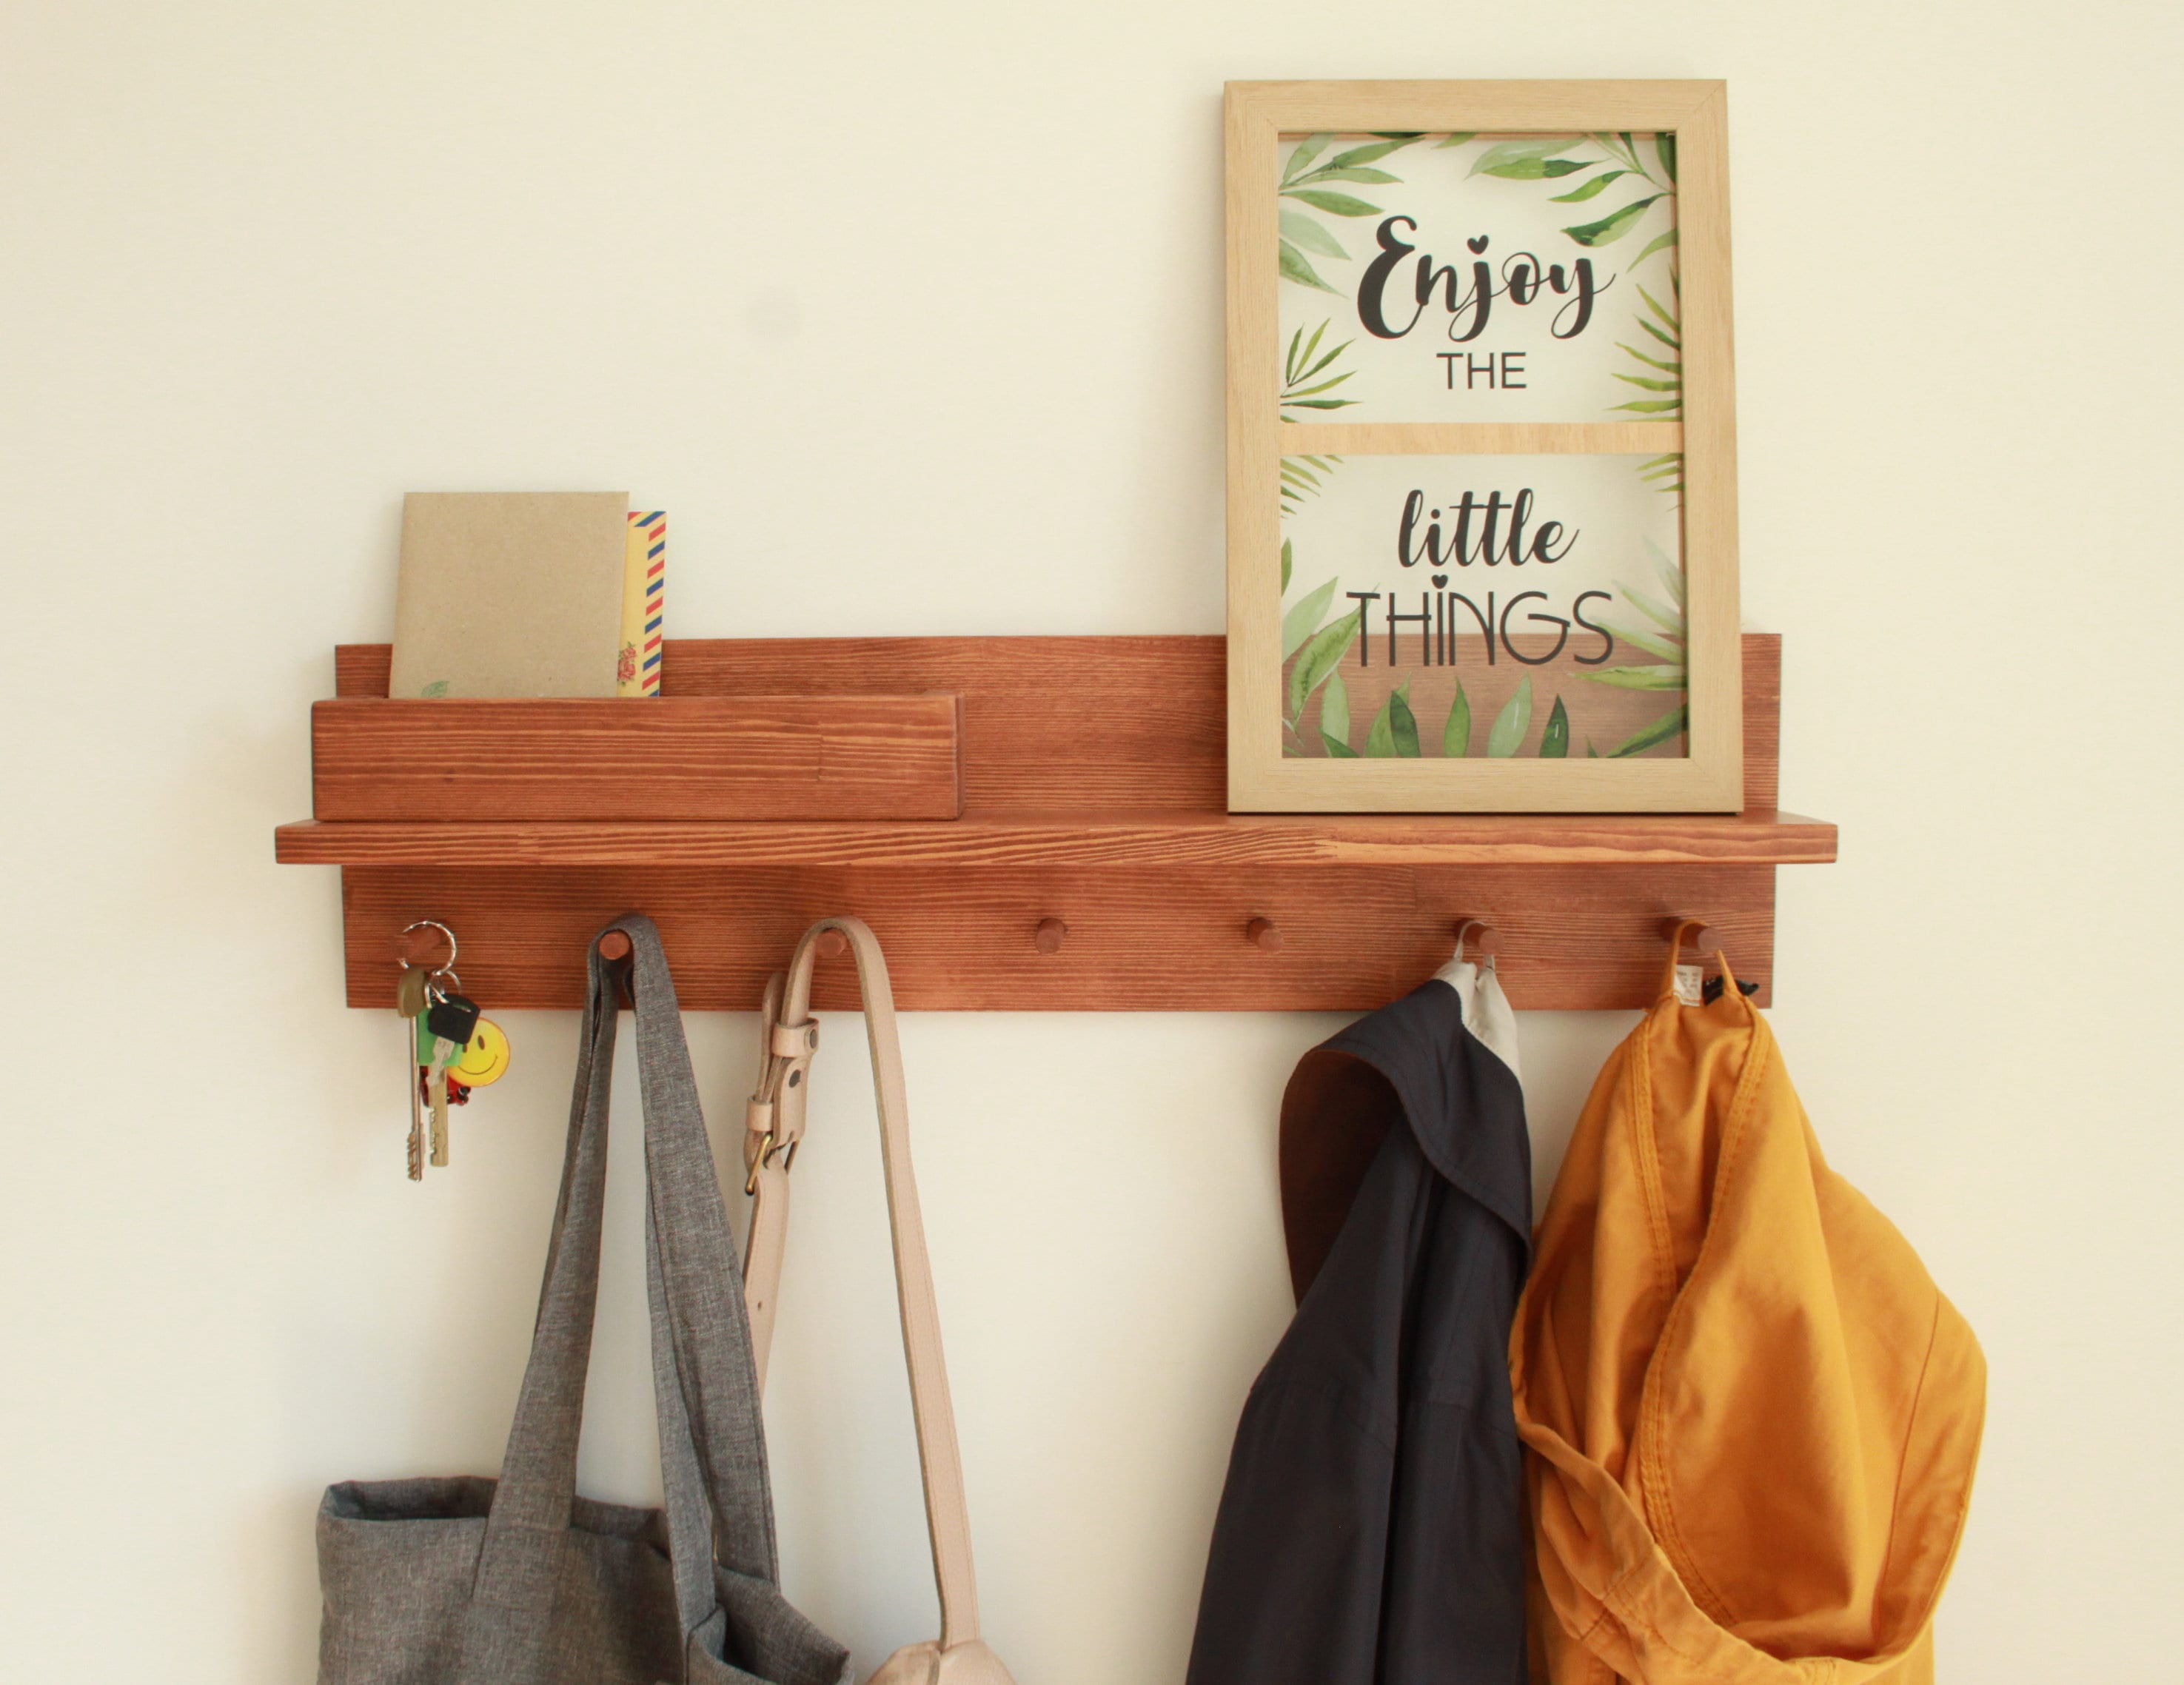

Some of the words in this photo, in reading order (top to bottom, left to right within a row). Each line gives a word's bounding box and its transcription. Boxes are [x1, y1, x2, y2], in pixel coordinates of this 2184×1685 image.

[1357, 215, 1616, 342] Enjoy
[1436, 352, 1527, 389] THE
[1398, 488, 1579, 568] little
[1346, 574, 1614, 666] THINGS
